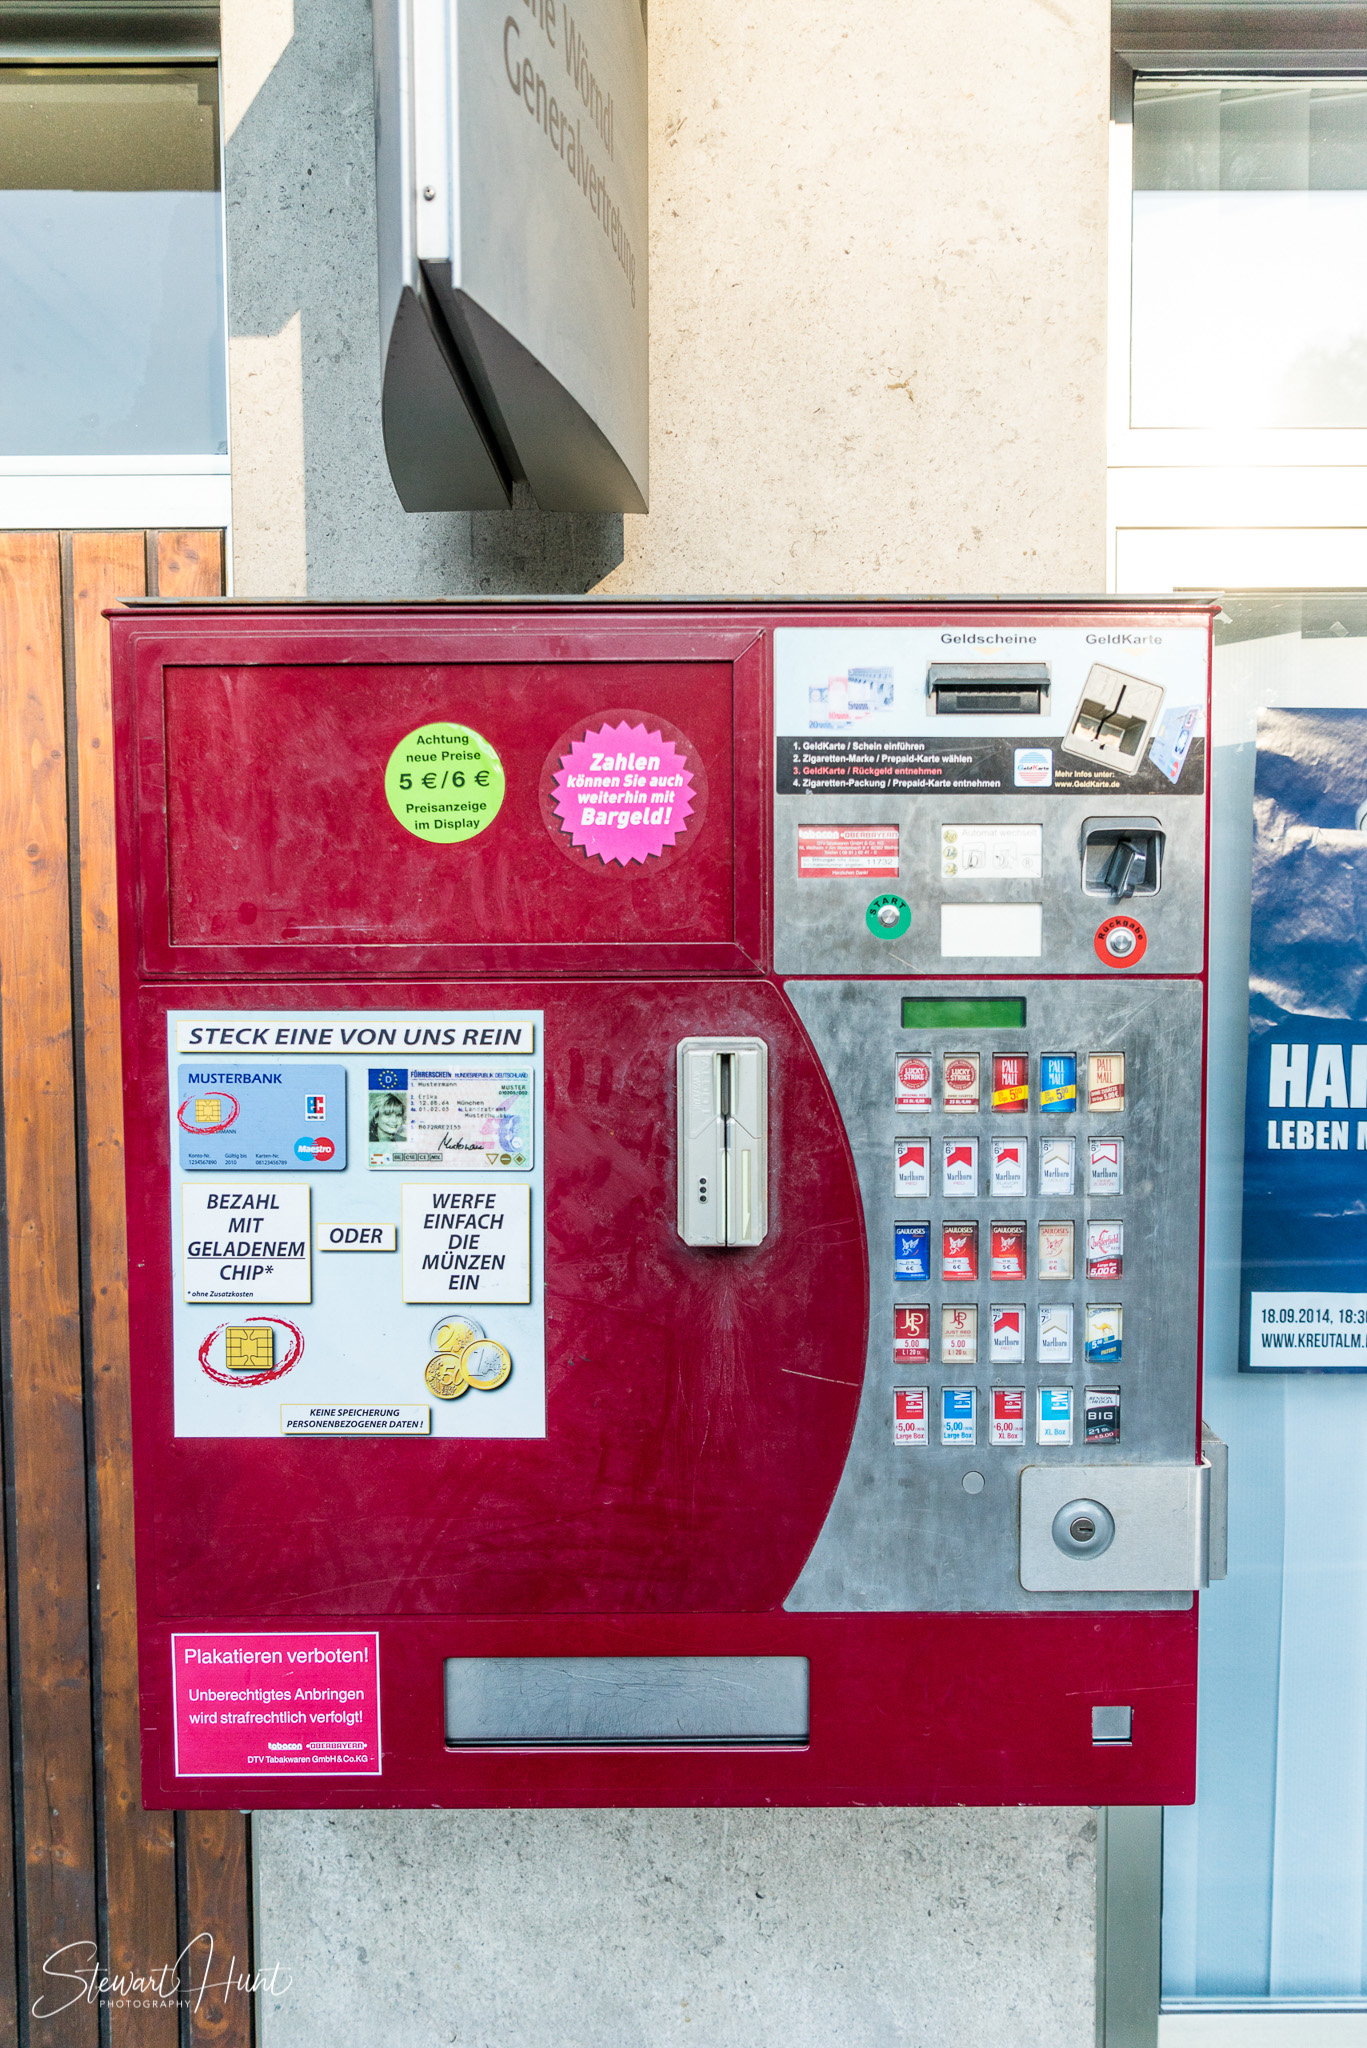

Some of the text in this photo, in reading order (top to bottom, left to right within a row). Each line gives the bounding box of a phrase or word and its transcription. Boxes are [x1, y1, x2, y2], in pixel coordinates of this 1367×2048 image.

[564, 5, 613, 162] Wörndl
[504, 16, 636, 309] Generalvertretung
[941, 633, 1037, 644] Geldscheine
[1086, 635, 1162, 645] GeldKarte
[416, 734, 469, 746] Achtung
[793, 742, 801, 751] 1.
[803, 742, 845, 751] GeldKarte
[852, 742, 882, 751] Schein
[884, 742, 925, 751] einführen
[406, 750, 481, 763] neue Preise
[589, 753, 660, 772] Zahlen
[793, 754, 801, 764] 2.
[802, 754, 874, 764] Zigaretten-Marke
[881, 754, 940, 764] Prepaid-Karte
[941, 754, 972, 764] wählen
[793, 767, 801, 776] 3.
[803, 767, 845, 776] GeldKarte
[852, 767, 893, 776] Rückgeld
[895, 767, 942, 776] entnehmen
[1055, 770, 1072, 778] Mehr
[399, 773, 413, 790] 5
[567, 774, 684, 788] können Sie auch
[793, 779, 801, 789] 4.
[802, 779, 886, 789] Zigaretten-Packung
[893, 779, 951, 789] Prepaid-Karte
[953, 779, 1001, 789] entnehmen
[577, 790, 675, 804] weiterhin mit
[406, 801, 488, 815] Preisanzeige
[414, 817, 480, 831] im Display
[580, 807, 672, 829] Bargeld!
[962, 829, 1037, 837] Automat wechselt
[869, 897, 906, 915] START
[1098, 919, 1143, 940] Rückgabe
[189, 1028, 522, 1045] STECK EINE VON UNS REIN
[1002, 1060, 1018, 1072] PALL
[1049, 1060, 1064, 1072] PALL
[1097, 1059, 1112, 1071] PALL
[188, 1073, 282, 1085] MUSTERBANK
[385, 1076, 392, 1084] D
[410, 1070, 452, 1078] FÜHRERSCHEIN
[1002, 1073, 1018, 1085] MALL
[1049, 1073, 1064, 1085] MALL
[1097, 1072, 1113, 1084] MALL
[1267, 1121, 1349, 1150] LEBEN
[298, 1145, 332, 1153] Maestro
[899, 1171, 924, 1180] Marlboro
[947, 1170, 972, 1180] Marlboro
[996, 1170, 1020, 1181] Marlboro
[1044, 1168, 1069, 1178] Marlboro
[1092, 1168, 1117, 1178] Marlboro
[207, 1194, 280, 1210] BEZAHL
[432, 1194, 496, 1209] WERFE
[228, 1218, 264, 1233] MIT
[423, 1214, 504, 1230] EINFACH
[329, 1228, 383, 1244] ODER
[448, 1235, 480, 1250] DIE
[187, 1242, 305, 1257] GELADENEM
[422, 1252, 505, 1270] MÜNZEN
[448, 1275, 480, 1290] EIN
[900, 1309, 923, 1337] JPS
[949, 1309, 967, 1330] JPS
[1261, 1309, 1367, 1325] 18.09.2014, 18:3
[994, 1336, 1019, 1346] Marlboro
[1042, 1337, 1067, 1347] Marlboro
[1262, 1333, 1367, 1348] WWW.KREUTALM.
[310, 1409, 400, 1417] KEINE SPEICHERUNG
[1088, 1412, 1113, 1420] BIG
[286, 1420, 387, 1429] PERSONENBEZOGENER
[389, 1420, 417, 1429] DATEN
[185, 1647, 368, 1664] Plakatieren verboten!
[189, 1688, 364, 1704] Unberechtigtes Anbringen
[189, 1711, 363, 1726] wird strafrechtlich verfolgt!
